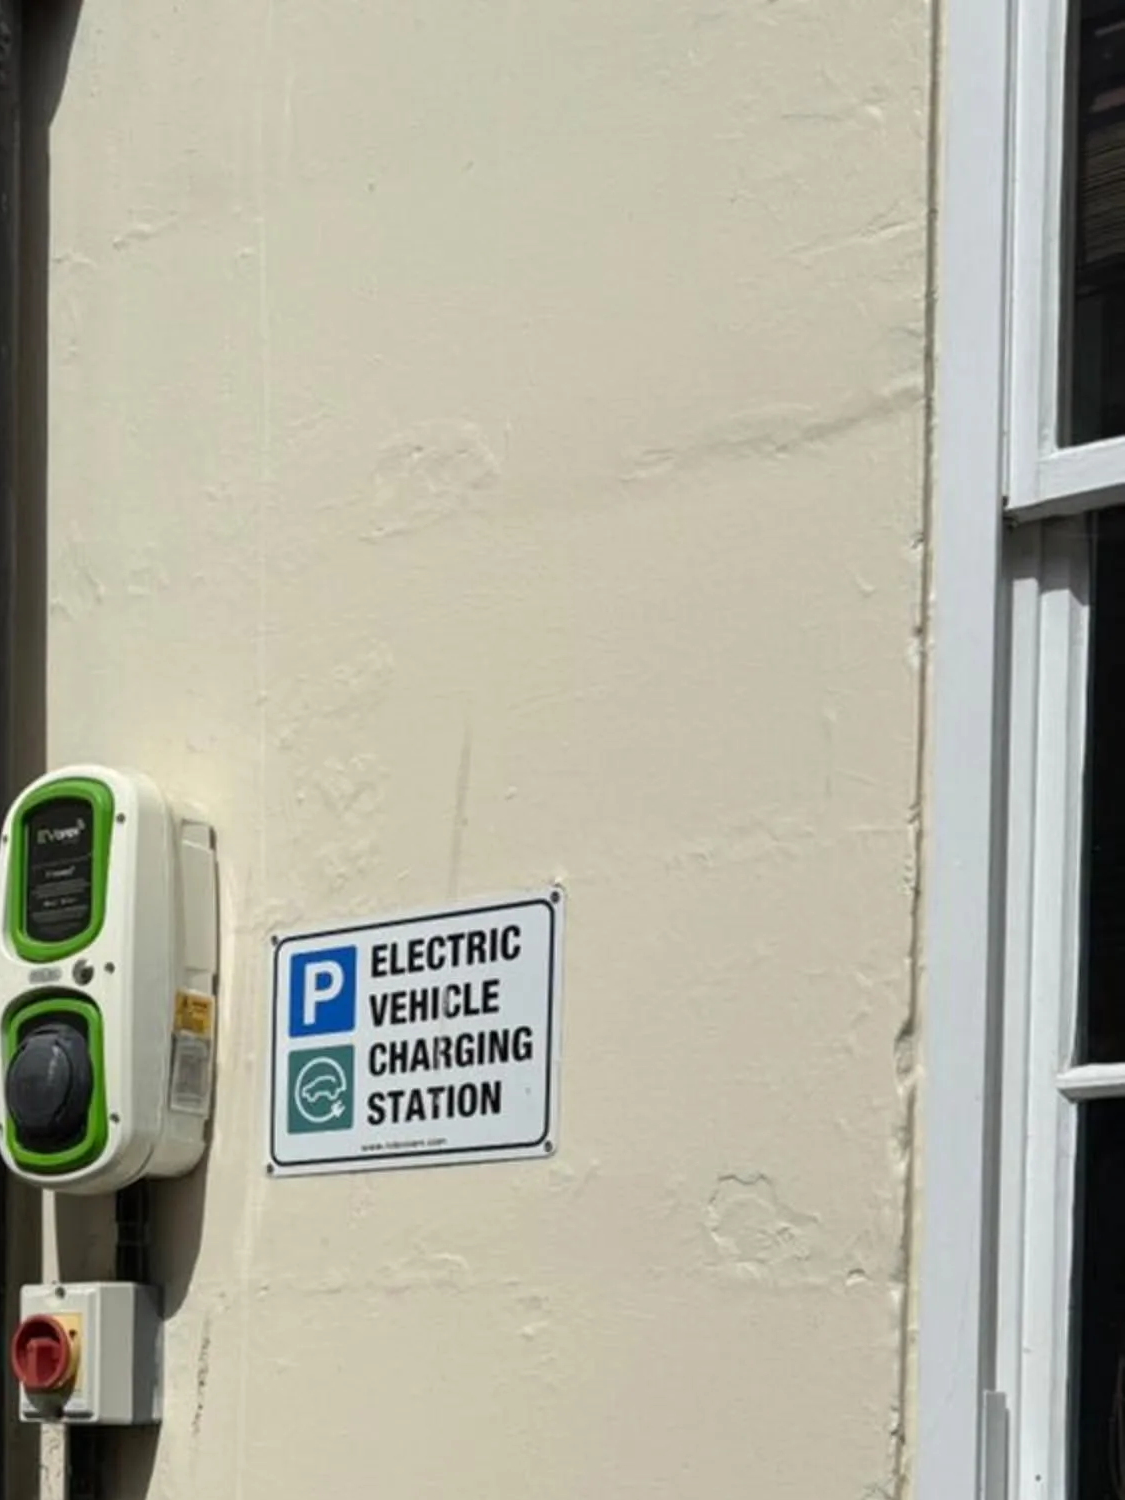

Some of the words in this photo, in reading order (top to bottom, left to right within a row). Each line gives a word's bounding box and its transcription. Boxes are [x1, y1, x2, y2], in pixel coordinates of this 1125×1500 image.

[371, 925, 521, 978] ELECTRIC
[303, 960, 344, 1026] P
[369, 979, 500, 1027] VEHICLE
[368, 1026, 533, 1077] CHARGING
[367, 1080, 502, 1126] STATION
